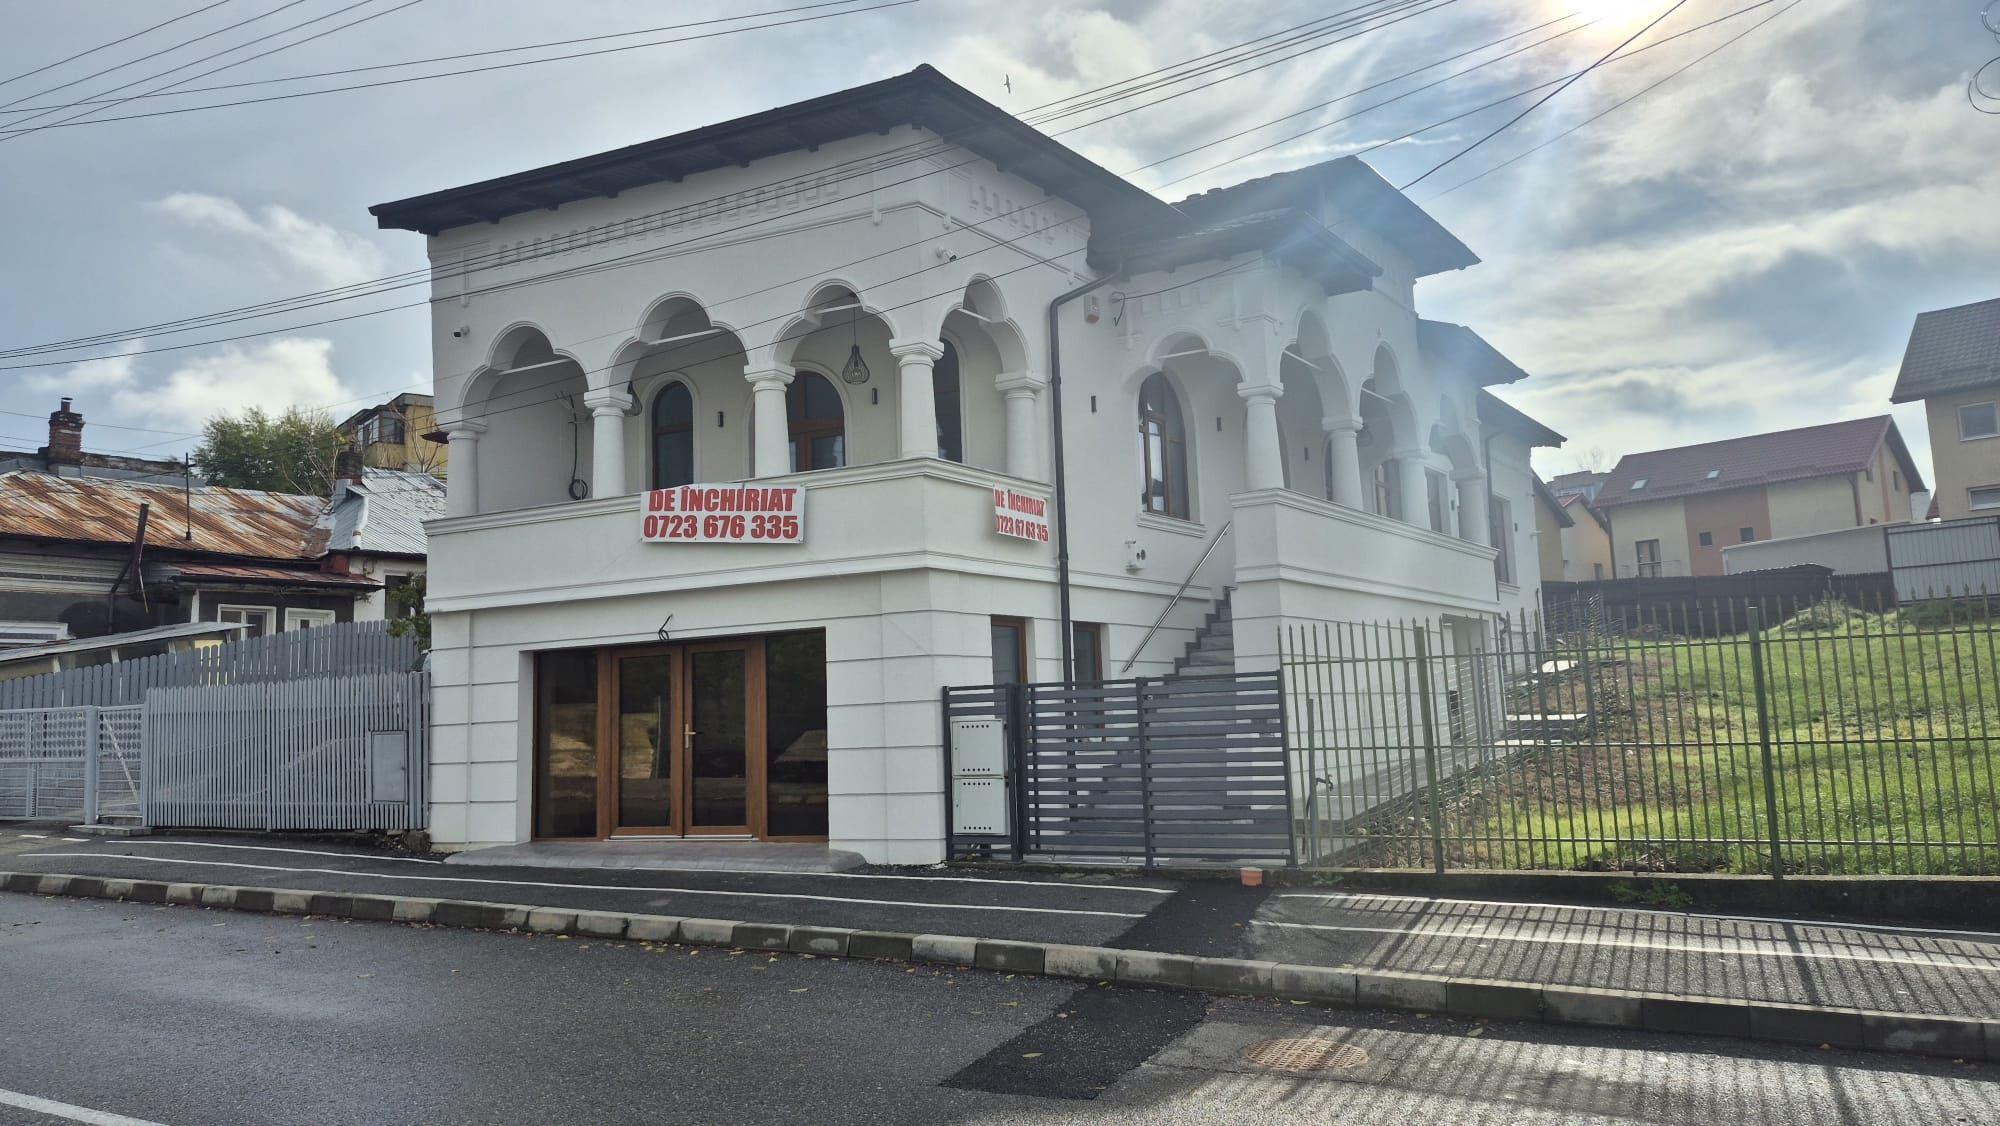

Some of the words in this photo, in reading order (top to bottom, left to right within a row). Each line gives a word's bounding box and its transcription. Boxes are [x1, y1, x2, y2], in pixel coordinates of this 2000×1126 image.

[649, 490, 675, 512] DE
[680, 486, 797, 512] ÎNCHIRIAT
[995, 489, 1005, 508] DE
[1007, 490, 1044, 517] ÎNCHIRIAT
[643, 515, 698, 538] 0723
[703, 515, 746, 538] 676
[751, 515, 799, 539] 335
